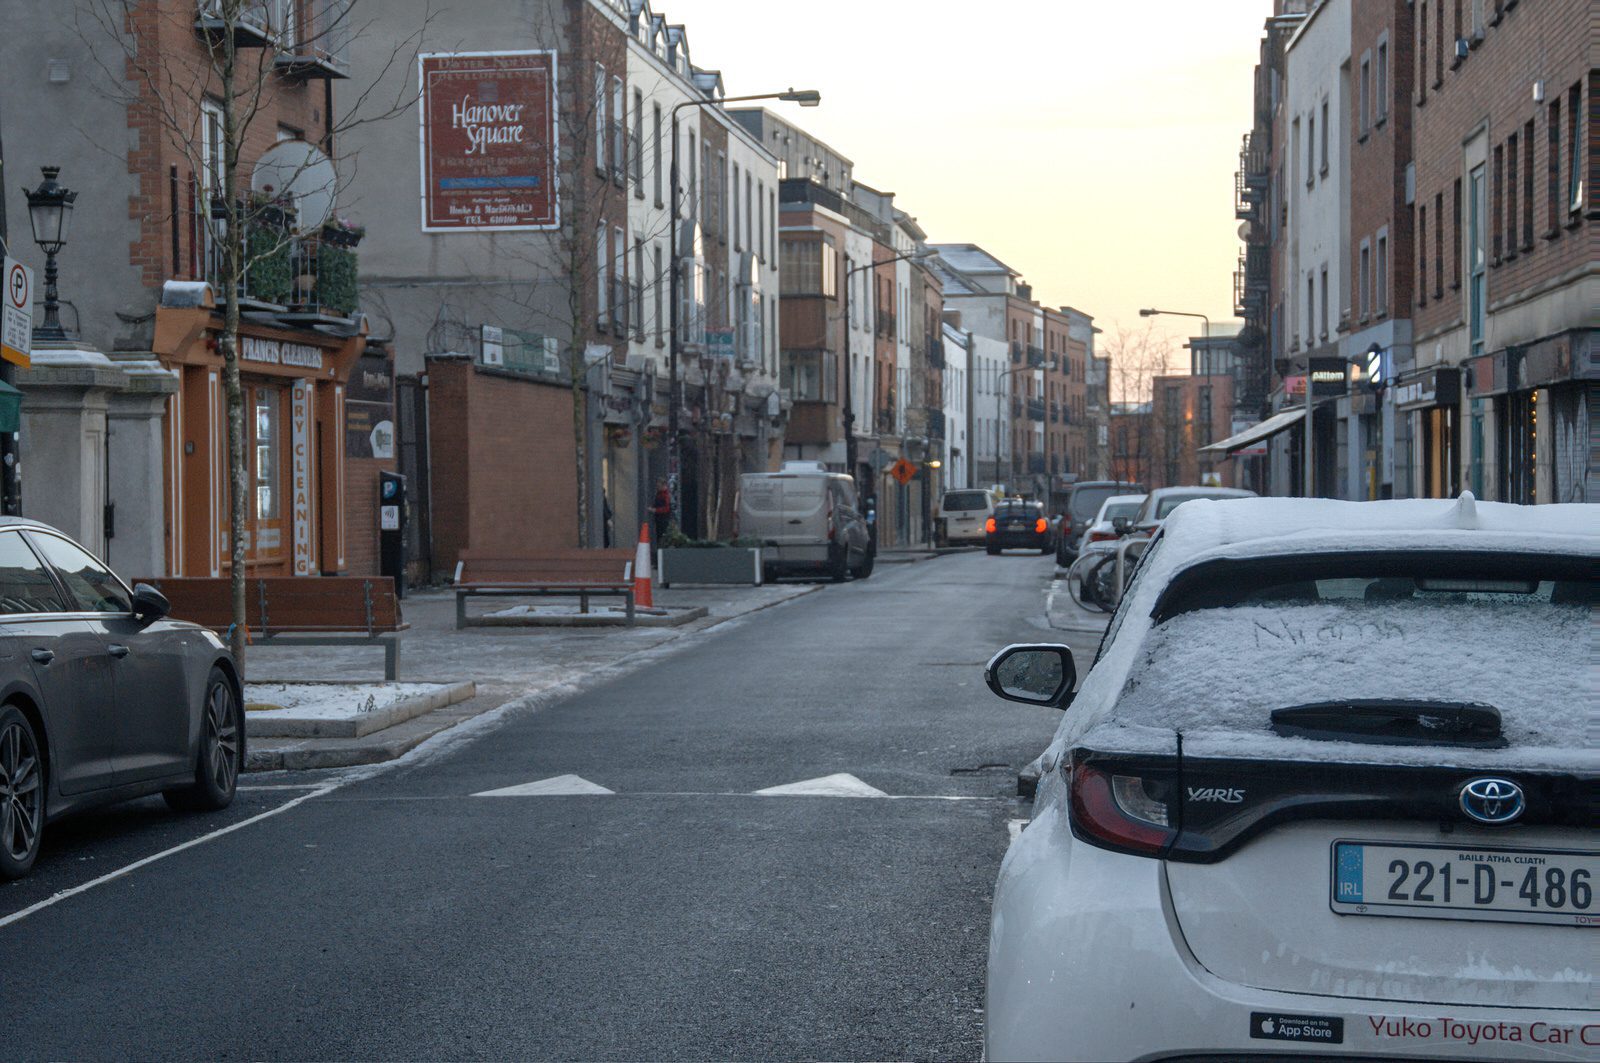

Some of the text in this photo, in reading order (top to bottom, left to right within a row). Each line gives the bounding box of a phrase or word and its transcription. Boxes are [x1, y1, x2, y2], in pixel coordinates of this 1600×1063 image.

[452, 94, 524, 128] Hanover
[464, 124, 524, 154] Square
[242, 337, 323, 369] FRANCIS CLEANERS
[1312, 370, 1345, 382] pattern
[294, 388, 308, 573] DRY CLEANING
[1187, 787, 1246, 804] YARIS
[1459, 853, 1484, 862] BAILE
[1514, 856, 1546, 866] CLIATH
[1340, 882, 1362, 896] IRL
[1387, 860, 1592, 910] 221-D-486
[1574, 916, 1596, 924] TOY
[1279, 1017, 1309, 1025] Download
[1278, 1024, 1332, 1038] App Store
[1368, 1015, 1432, 1038] Yuko
[1437, 1017, 1522, 1045] Toyota
[1529, 1021, 1574, 1044] Car
